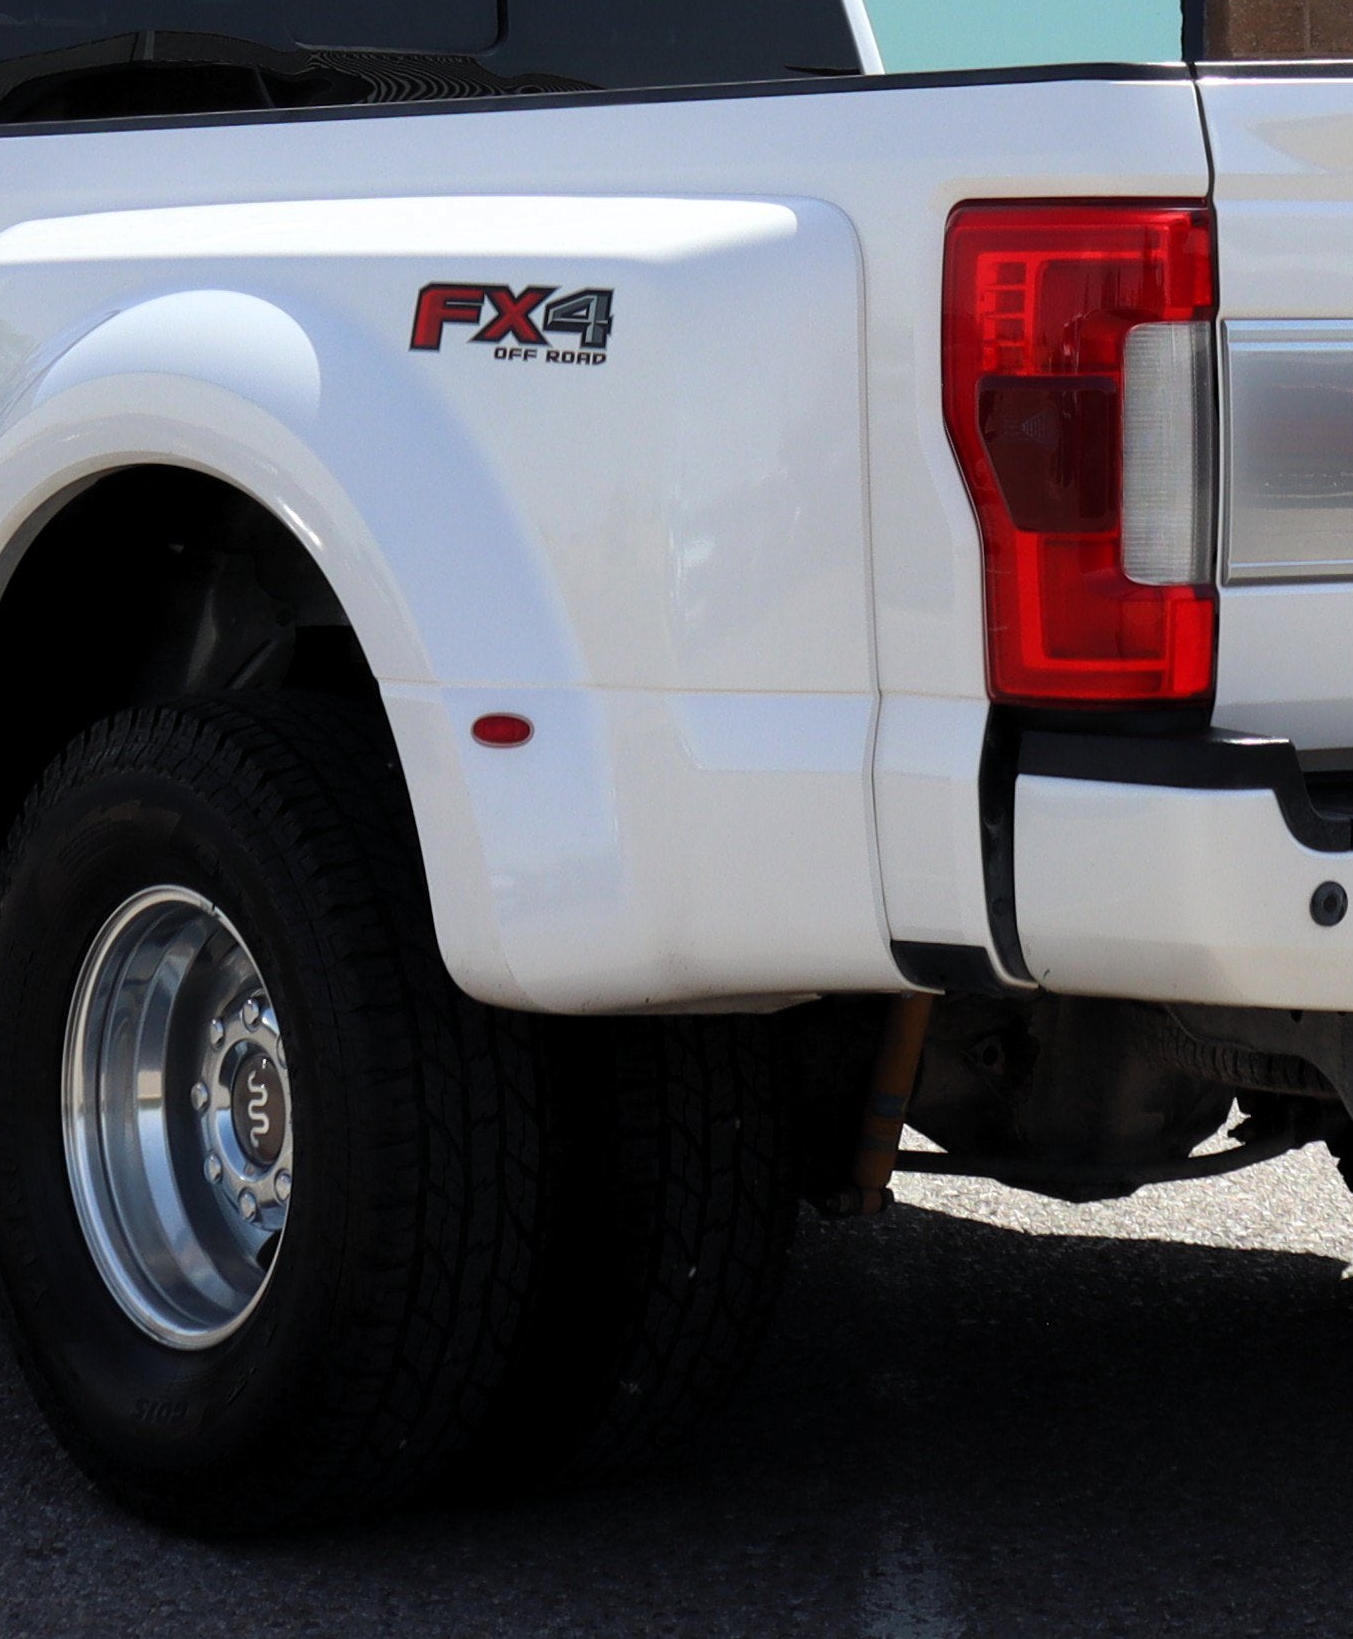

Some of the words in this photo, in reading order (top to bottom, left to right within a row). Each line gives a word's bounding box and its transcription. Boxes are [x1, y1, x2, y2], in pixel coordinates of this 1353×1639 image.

[408, 281, 614, 352] FX4
[494, 346, 537, 361] OFF
[546, 349, 607, 366] ROAD
